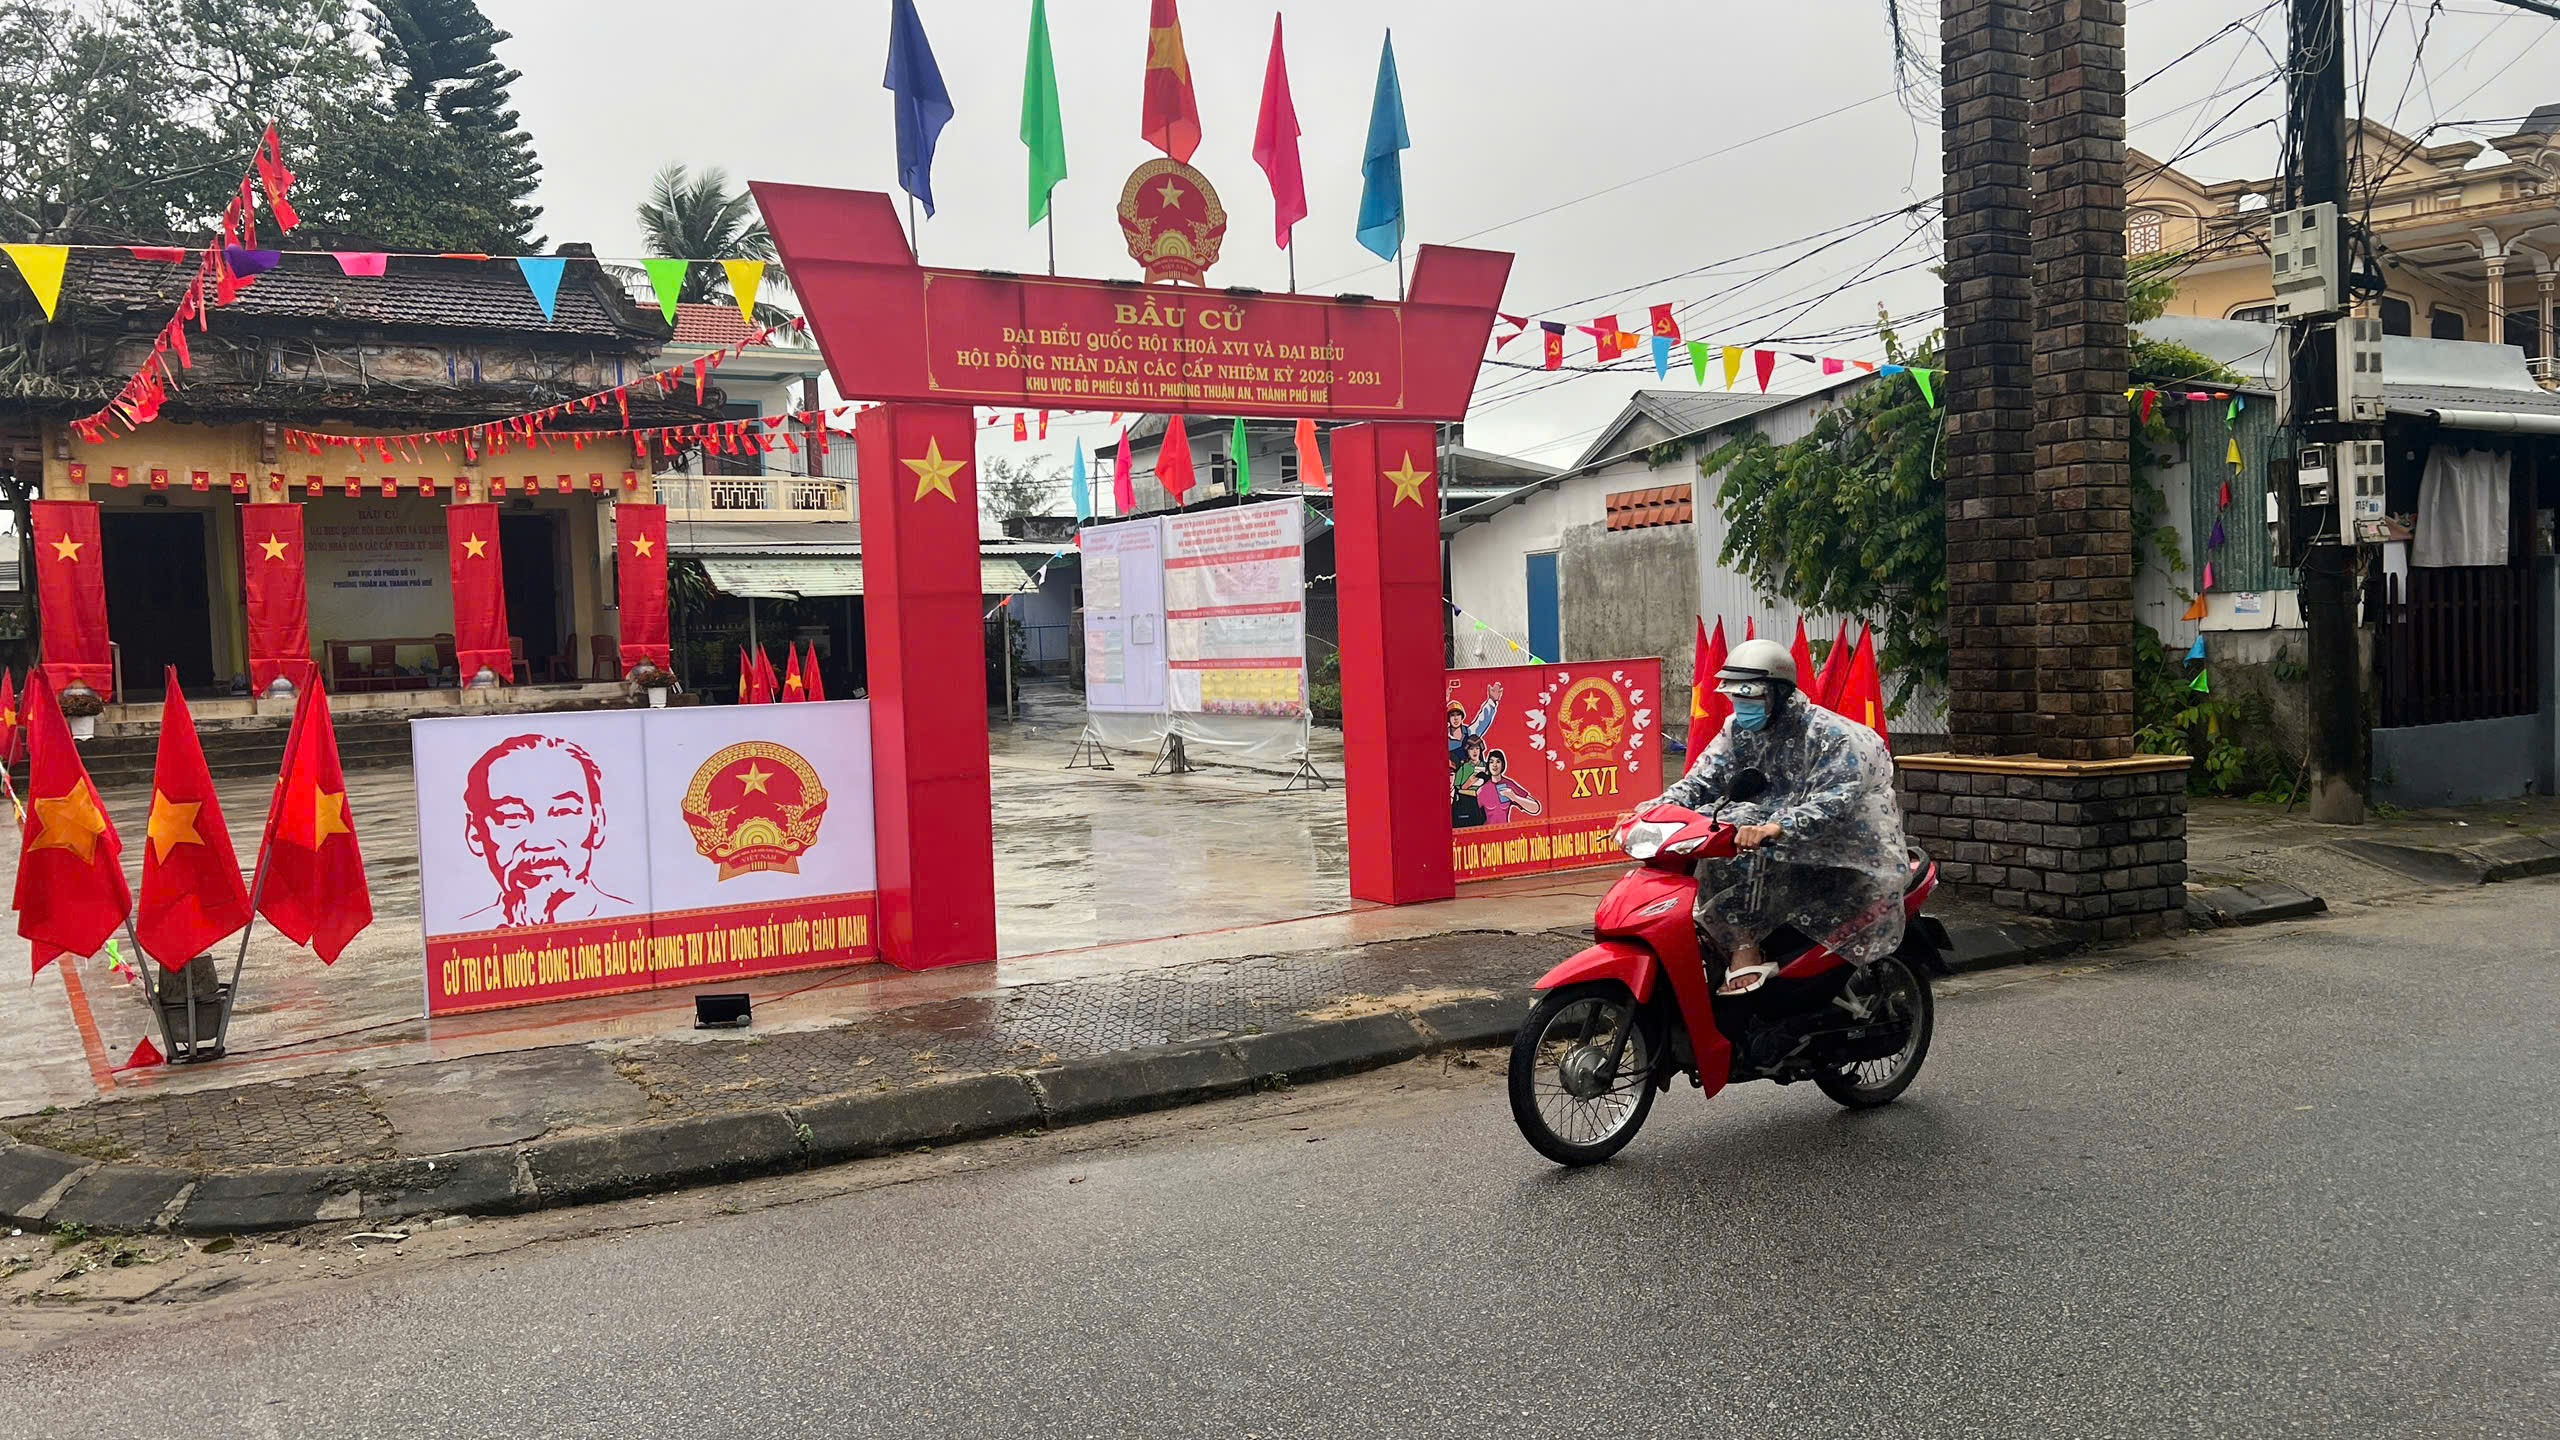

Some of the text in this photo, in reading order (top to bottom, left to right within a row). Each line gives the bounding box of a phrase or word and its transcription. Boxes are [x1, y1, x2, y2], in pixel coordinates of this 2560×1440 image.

[1114, 294, 1246, 331] BẦU CỬ
[1002, 323, 1344, 362] ĐẠI BIỂU QUỐC HỘI KHOÁ XVI VÀ ĐẠI BIỂU
[956, 347, 990, 370] HỘI
[995, 345, 1046, 370] ĐỒNG
[1050, 353, 1098, 373] NHÂN
[1103, 355, 1138, 375] DÂN
[1143, 358, 1177, 377] CÁC
[1182, 357, 1213, 378] CẤP
[1218, 362, 1269, 384] NHIỆM
[1273, 365, 1295, 382] KỲ
[1299, 369, 1334, 384] 2026
[1348, 370, 1381, 385] 2031
[1026, 375, 1328, 403] KHU VỰC BỎ PHIẾU SỐ 11, PHƯỜNG THUẬN AN, THÀNH PHỐ HUẾ
[1571, 766, 1619, 798] XVI
[1452, 838, 1462, 872] ỐT
[1463, 841, 1480, 875] LỰA
[1480, 841, 1503, 872] CHỌN
[1504, 832, 1528, 864] NGƯỜI
[1530, 832, 1551, 862] XỨNG
[1552, 829, 1574, 860] ĐÁNG
[1575, 831, 1588, 861] ĐẠI
[443, 912, 868, 996] CỬ TRI CẢ NƯỚC ĐỒNG LÒNG BẦU CỬ CHUNG TAY XÂY DỰNG ĐẤT NƯỚC GIÀU MẠNH
